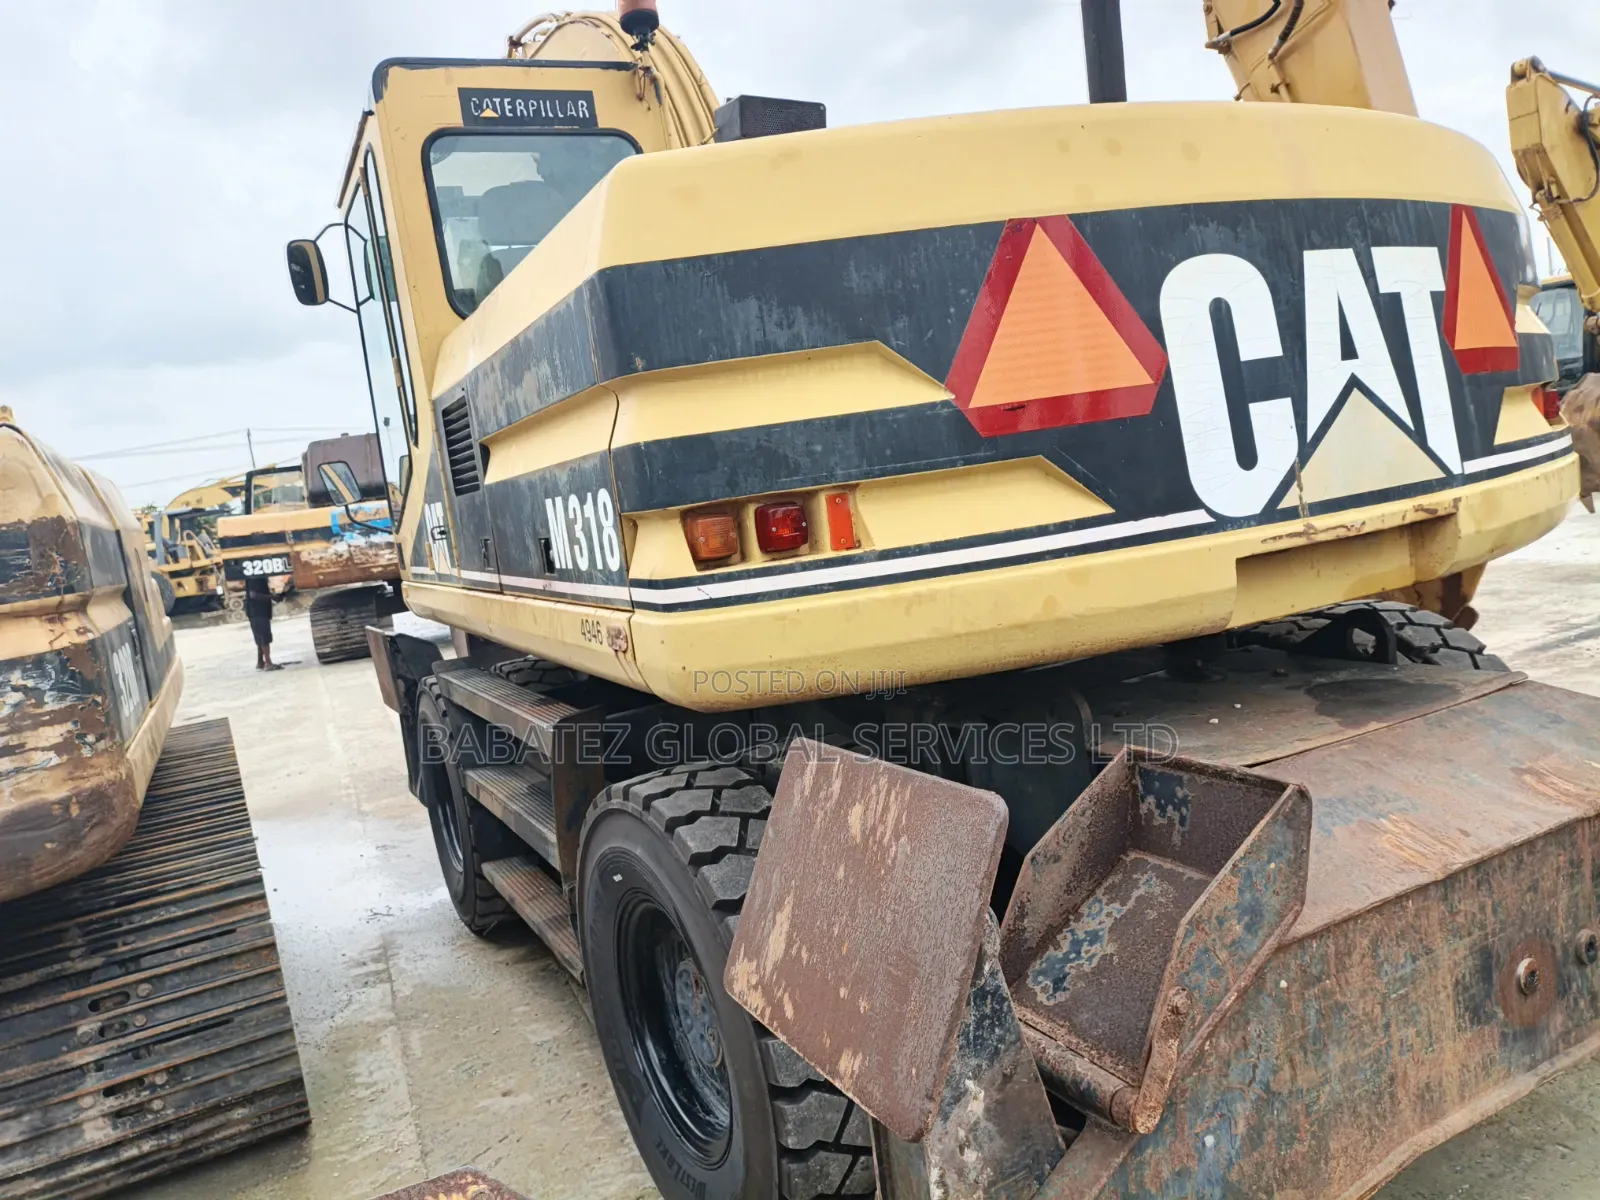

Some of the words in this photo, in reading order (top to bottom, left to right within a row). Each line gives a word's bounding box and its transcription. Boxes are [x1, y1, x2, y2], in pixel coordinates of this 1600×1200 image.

[470, 97, 590, 119] CATERPILLAR
[1160, 246, 1463, 518] CAT
[545, 487, 621, 572] M318
[580, 618, 603, 646] 4946
